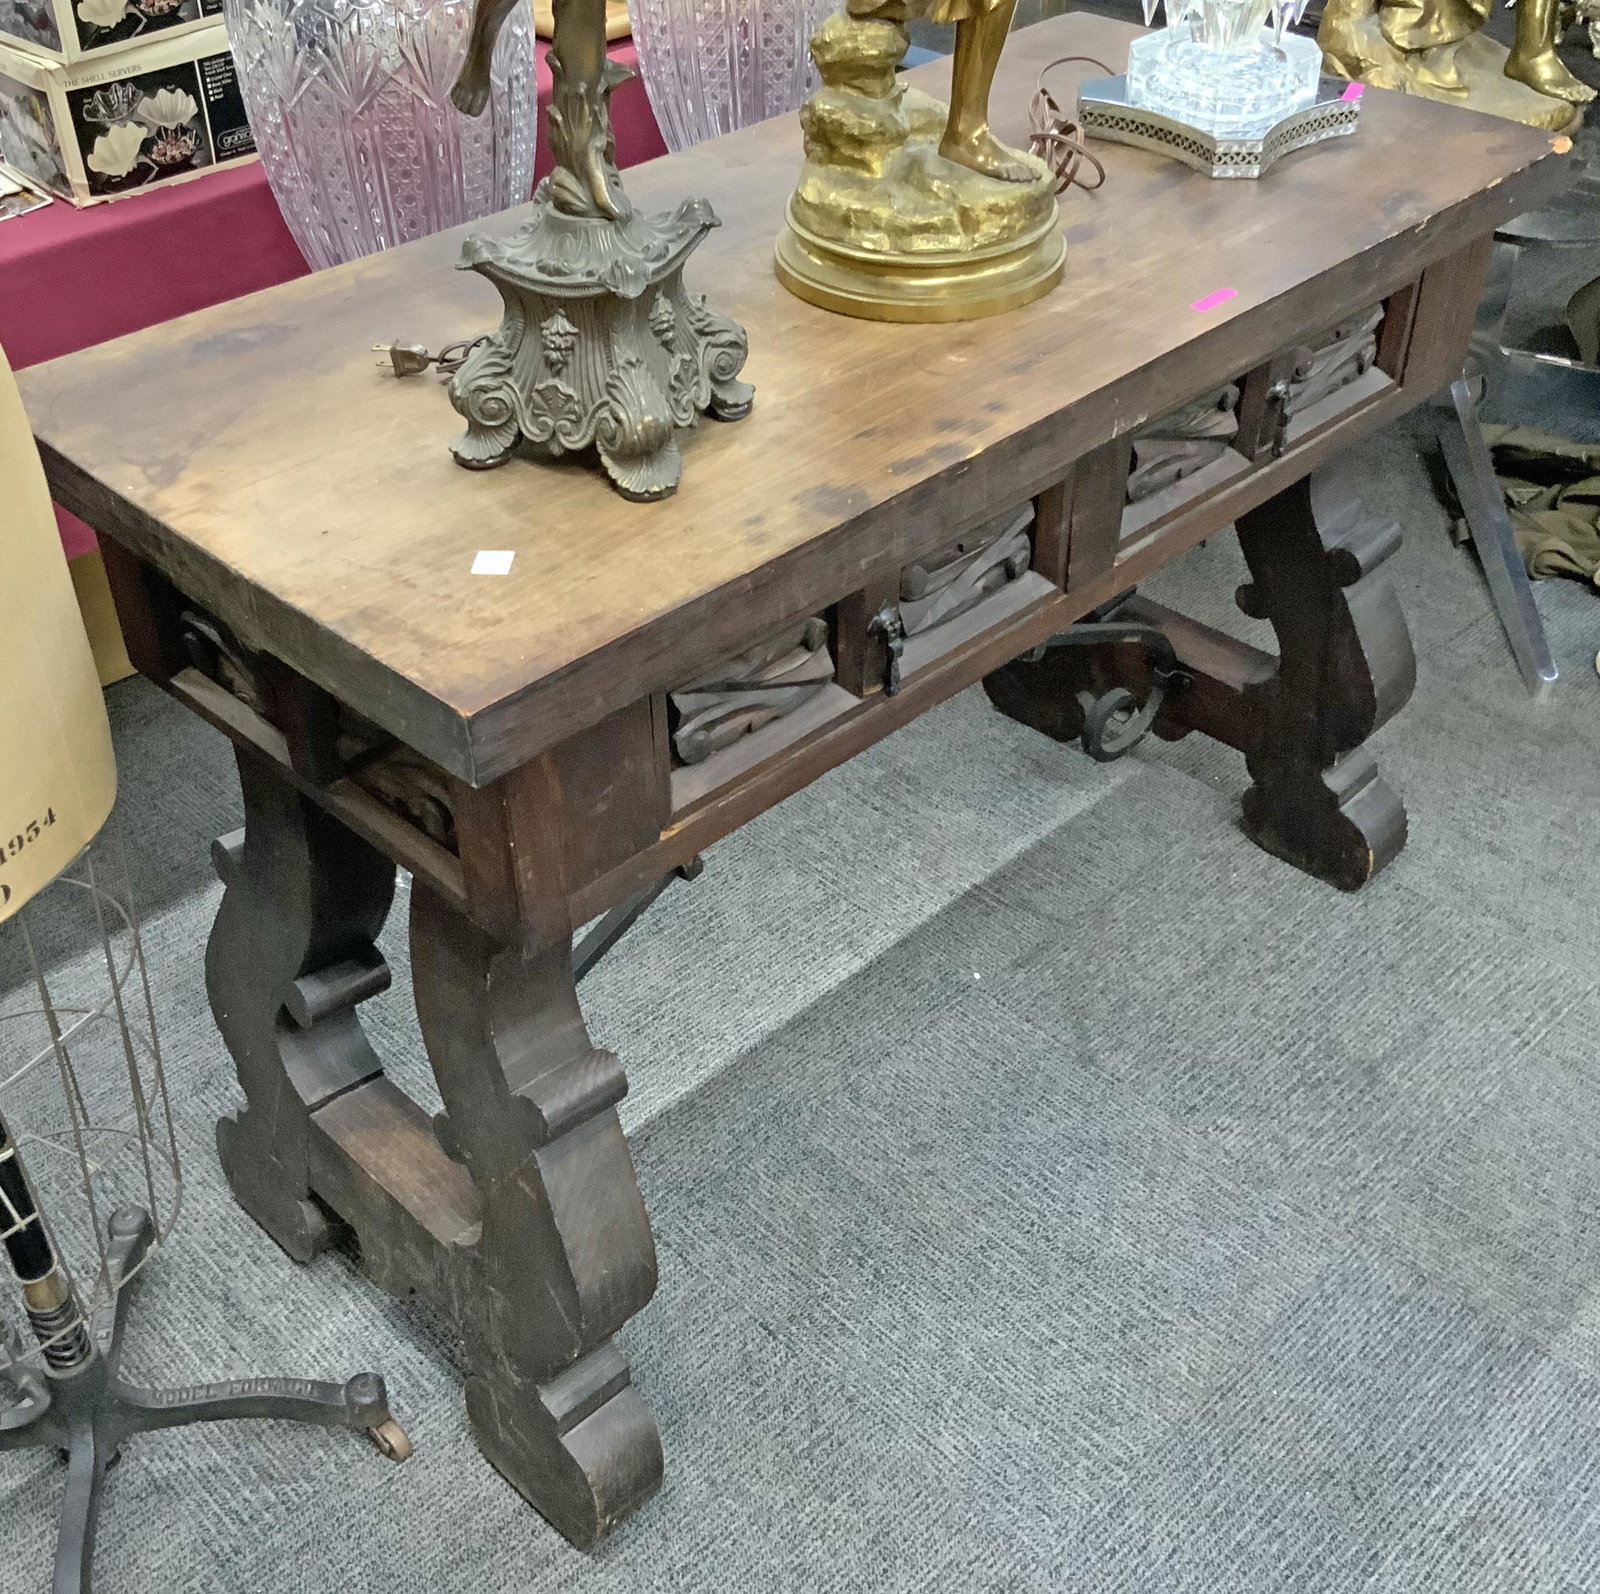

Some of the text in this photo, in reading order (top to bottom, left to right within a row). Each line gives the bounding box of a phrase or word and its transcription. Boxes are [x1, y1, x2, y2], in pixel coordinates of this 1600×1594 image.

[64, 64, 142, 88] THE SHELL SERVERS
